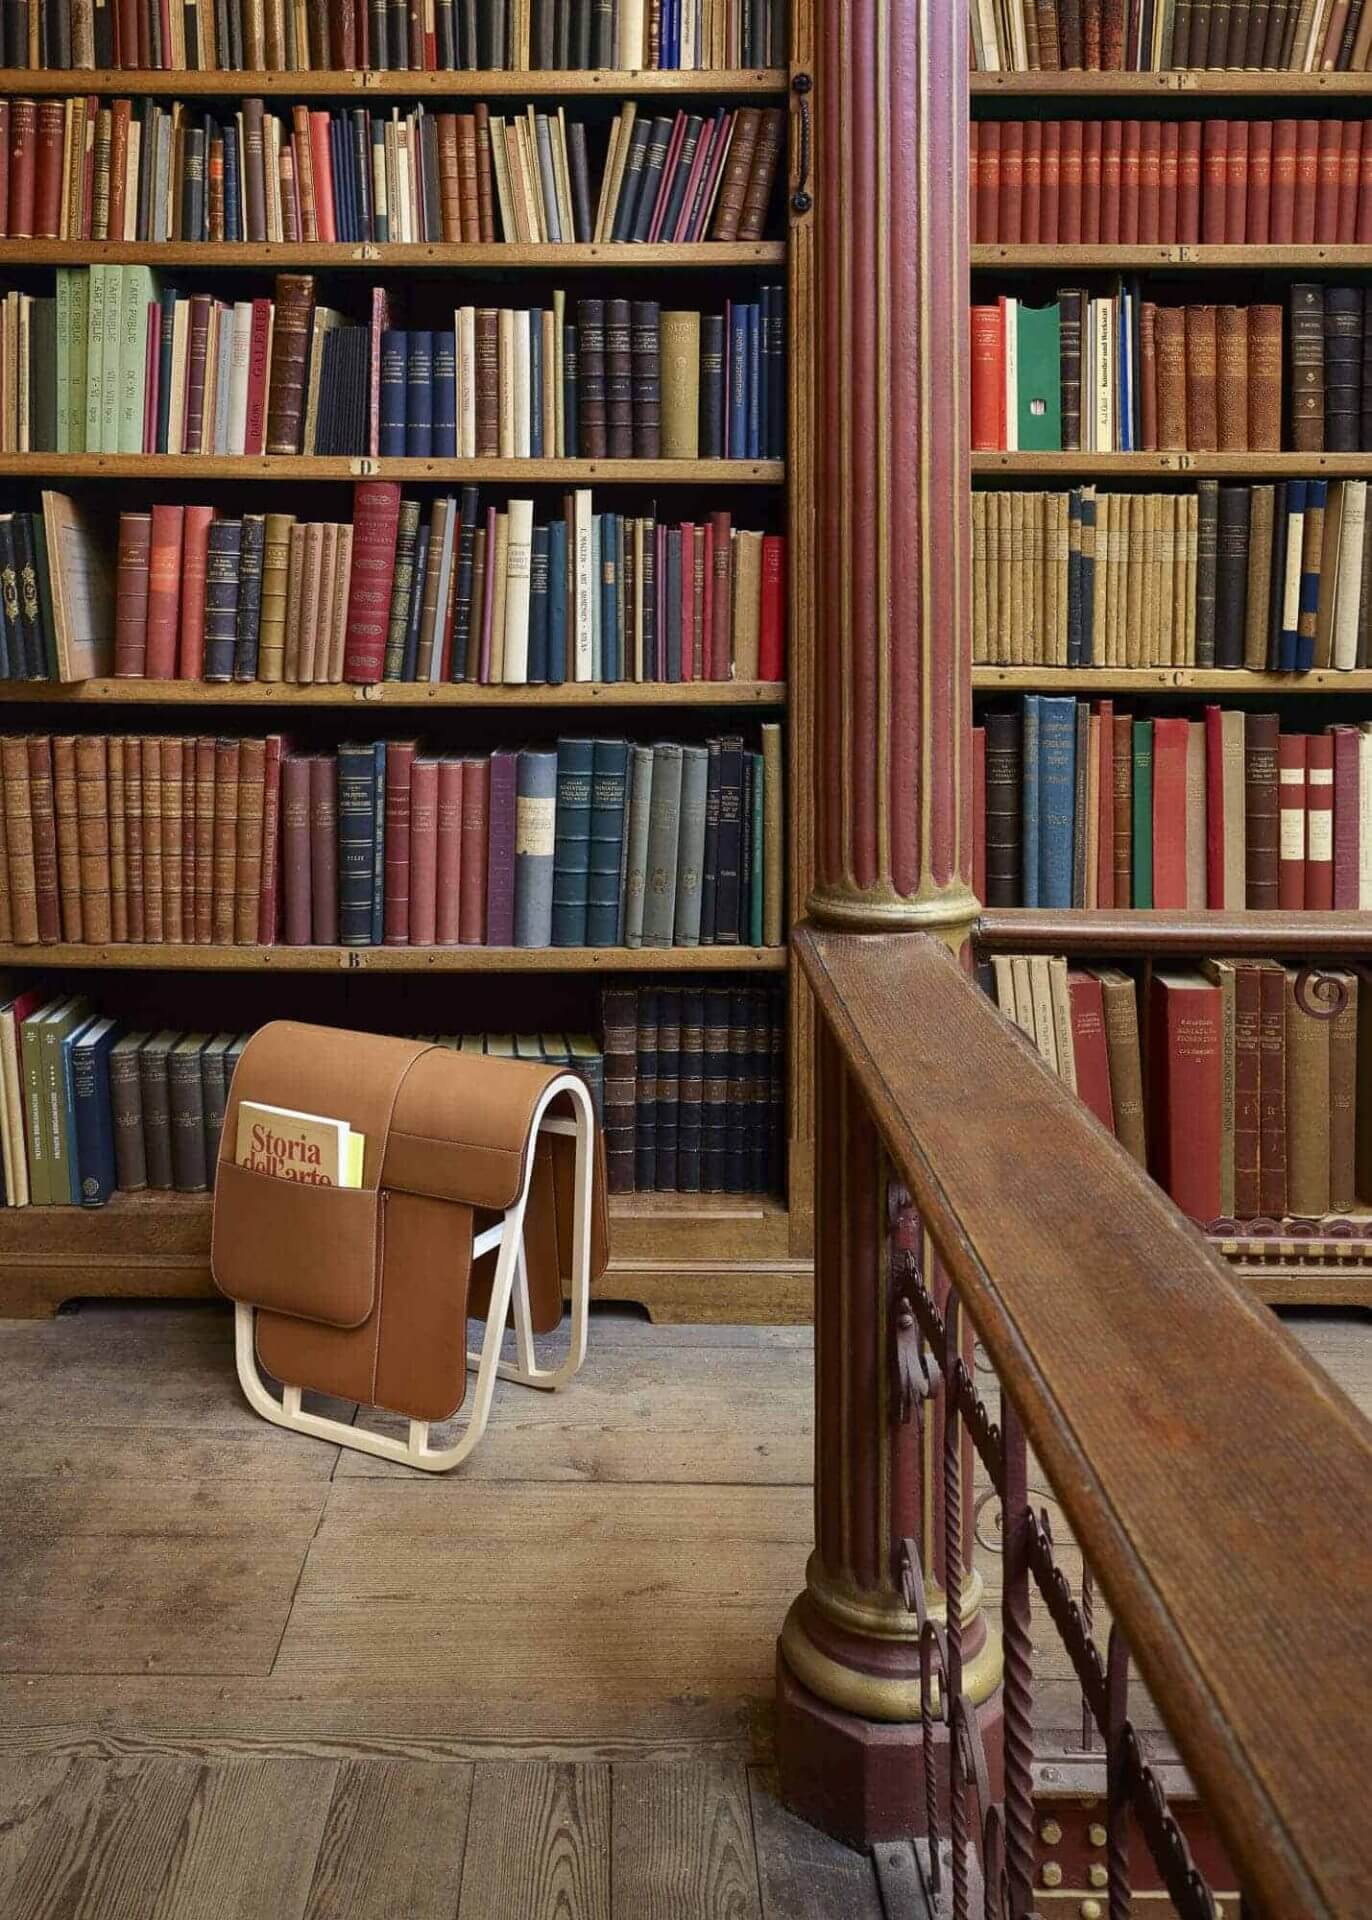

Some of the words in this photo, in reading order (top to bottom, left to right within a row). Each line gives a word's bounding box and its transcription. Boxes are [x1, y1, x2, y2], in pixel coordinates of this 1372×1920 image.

[1178, 247, 1191, 261] E
[94, 277, 103, 305] L'ART
[108, 278, 119, 305] L'ART
[129, 278, 139, 306] L'ART
[92, 308, 102, 343] PUBLIC
[106, 310, 117, 342] PUBLIC
[126, 309, 137, 344] PUBLIC
[359, 460, 372, 475] D
[1178, 455, 1190, 470] D
[362, 684, 374, 700] C
[1173, 671, 1184, 686] C
[348, 951, 360, 968] B
[251, 1123, 322, 1166] Storia
